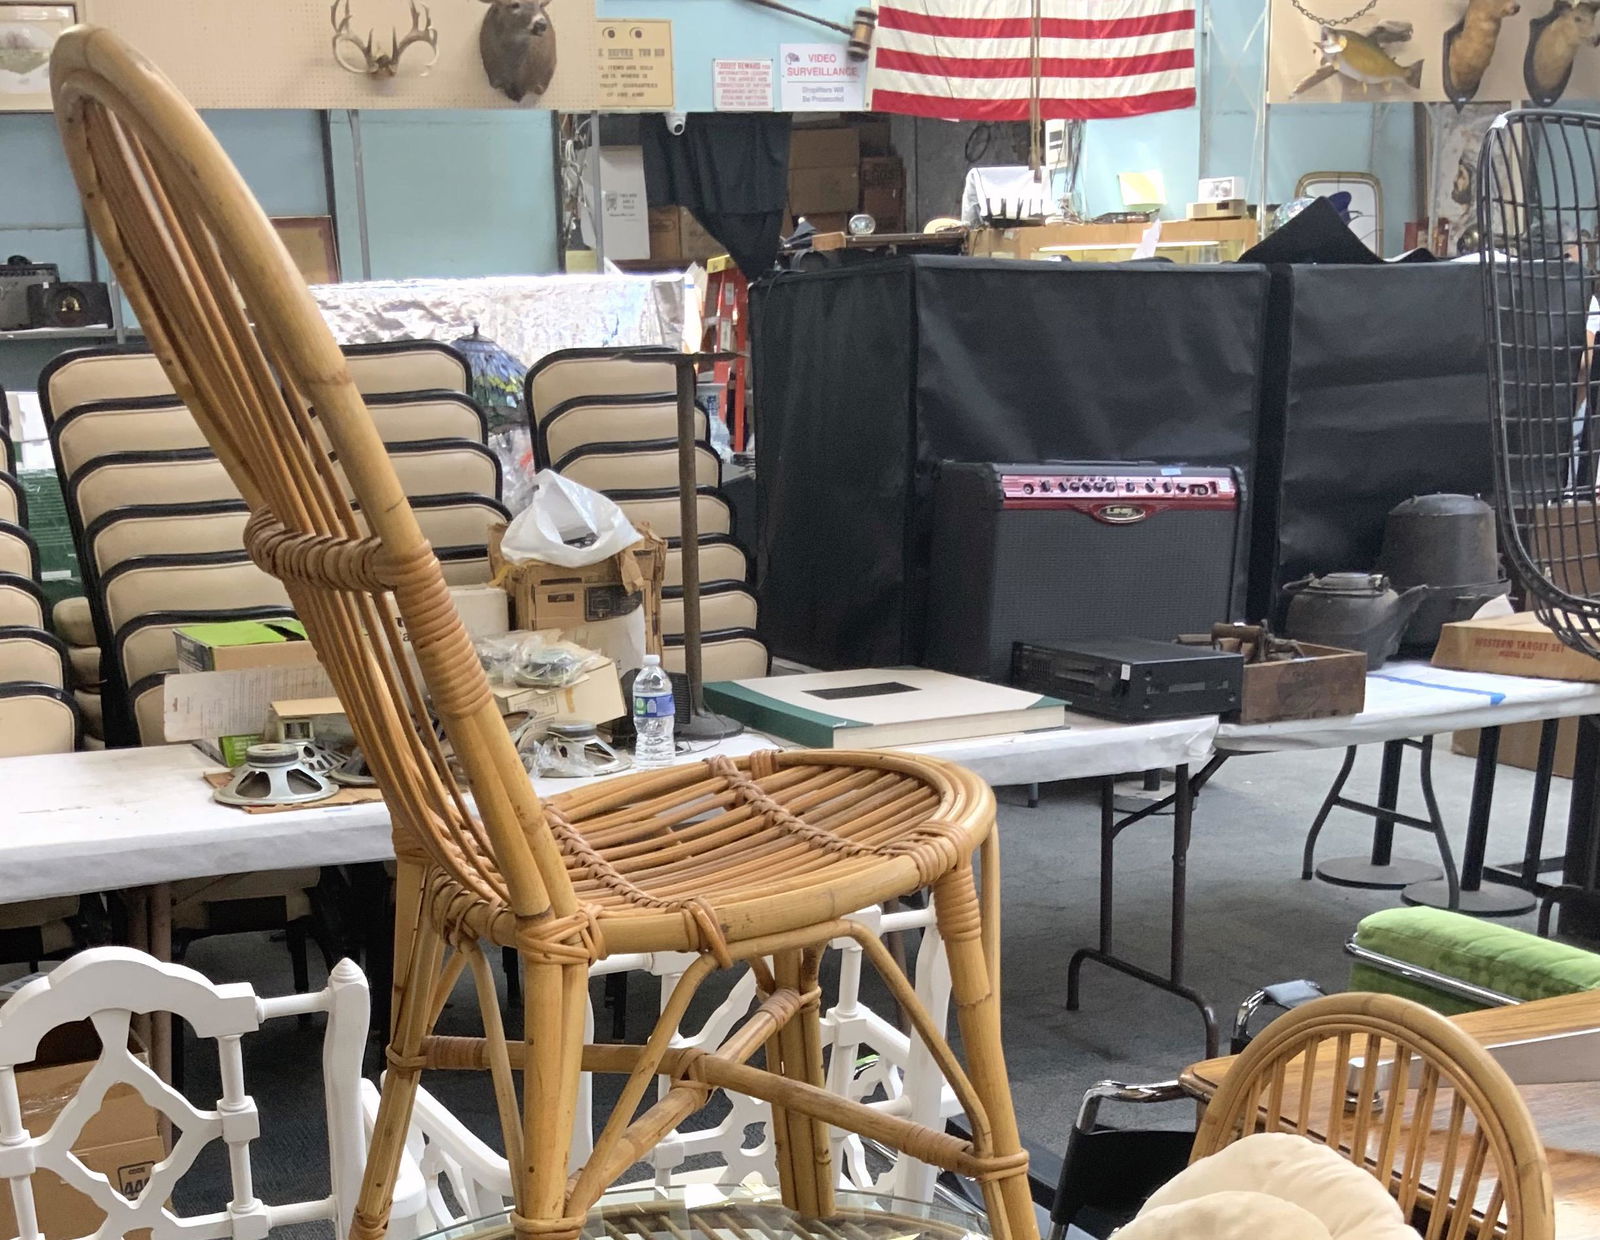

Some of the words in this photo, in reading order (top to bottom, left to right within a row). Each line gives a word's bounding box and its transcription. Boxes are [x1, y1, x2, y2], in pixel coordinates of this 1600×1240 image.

[808, 54, 837, 63] VIDEO
[787, 67, 858, 77] SURVEILLANCE
[1474, 638, 1514, 649] WESTERN
[1516, 640, 1549, 652] TARGET
[1551, 643, 1565, 654] SET
